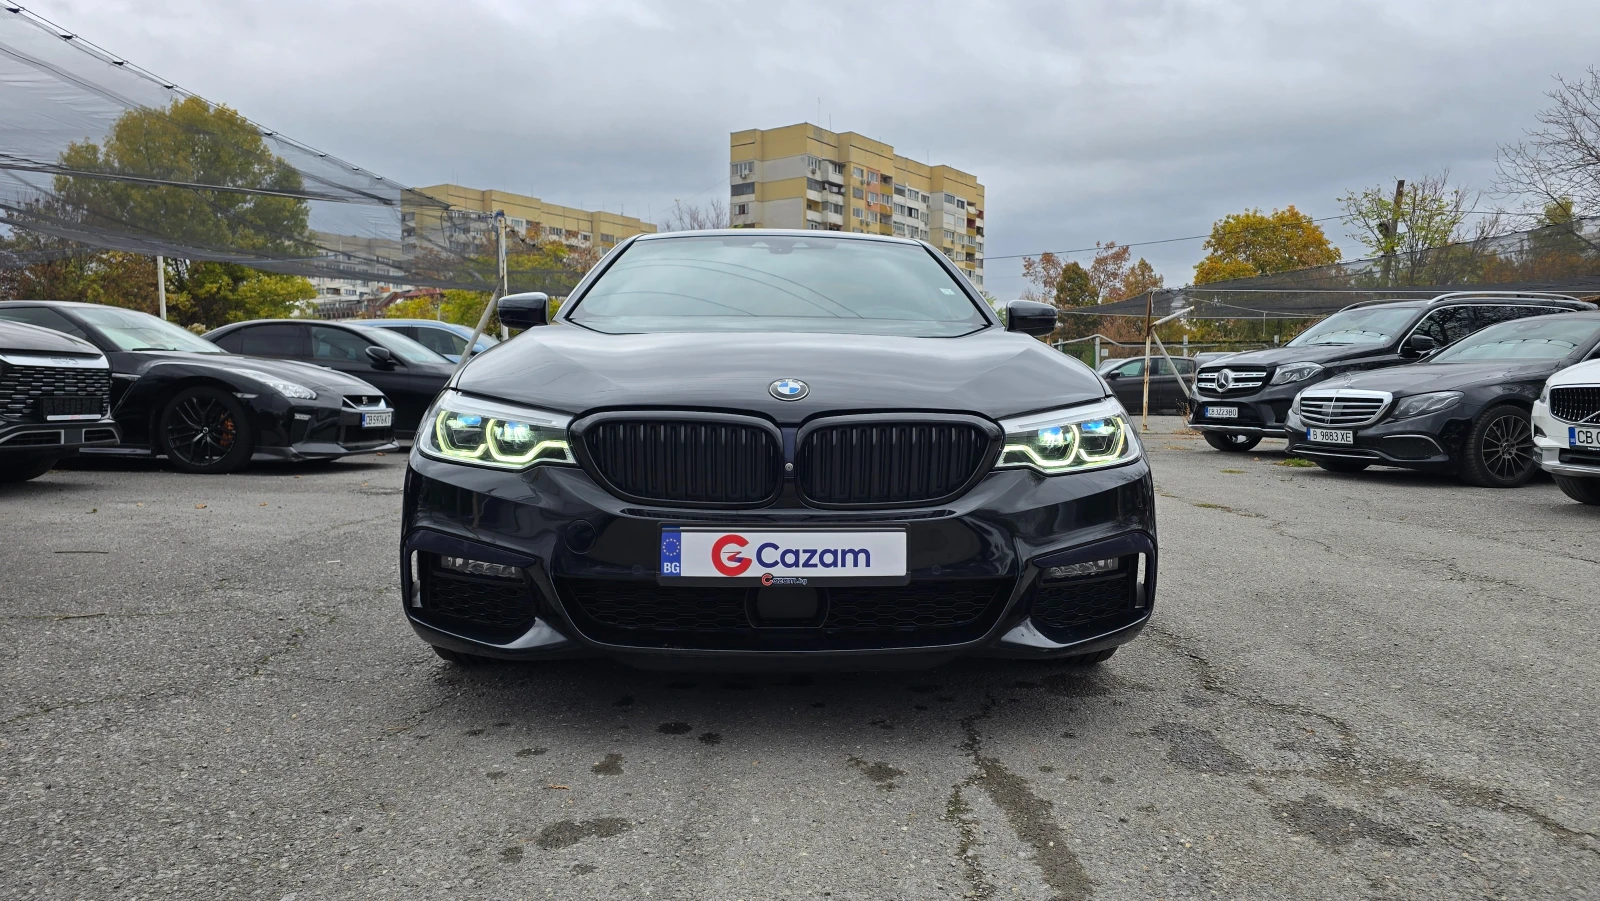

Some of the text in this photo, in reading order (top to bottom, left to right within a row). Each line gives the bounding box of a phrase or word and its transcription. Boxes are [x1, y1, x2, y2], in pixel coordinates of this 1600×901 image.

[1320, 431, 1339, 441] 9883
[1340, 432, 1352, 443] XE
[756, 542, 871, 569] Cazam
[663, 562, 680, 574] BG
